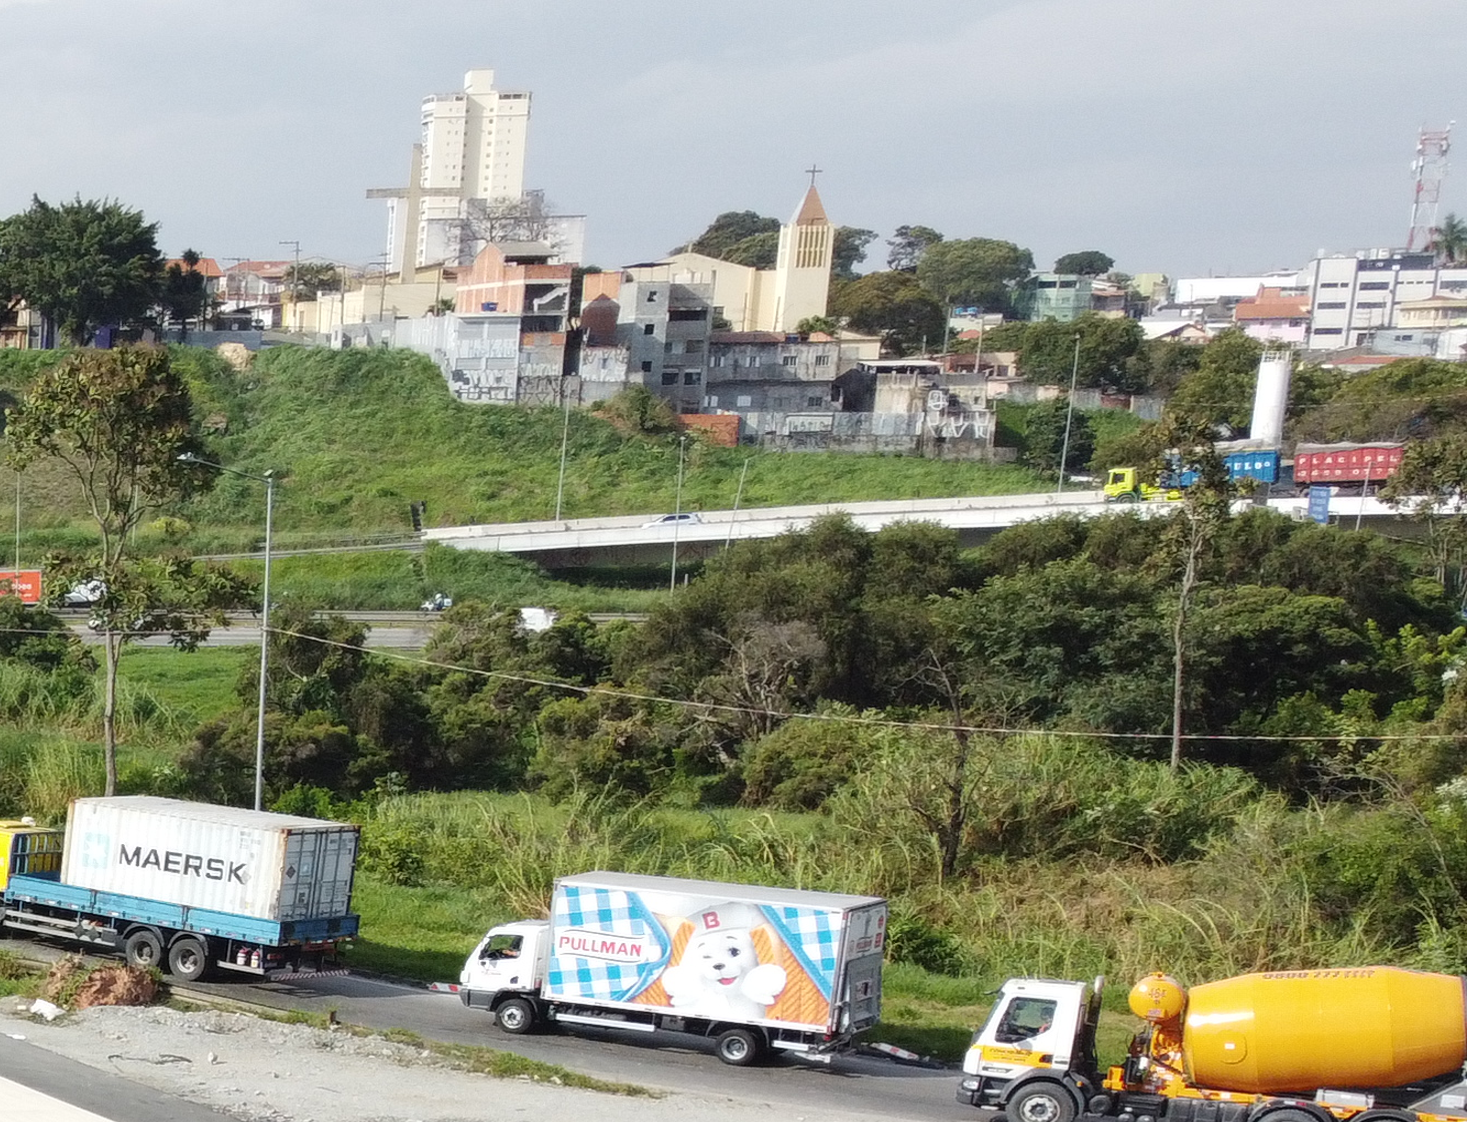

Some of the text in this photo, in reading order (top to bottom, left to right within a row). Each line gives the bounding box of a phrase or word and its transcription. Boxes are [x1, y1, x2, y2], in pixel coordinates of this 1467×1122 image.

[119, 843, 247, 886] MAERSK
[701, 911, 720, 930] B
[558, 935, 642, 958] PULLMAN
